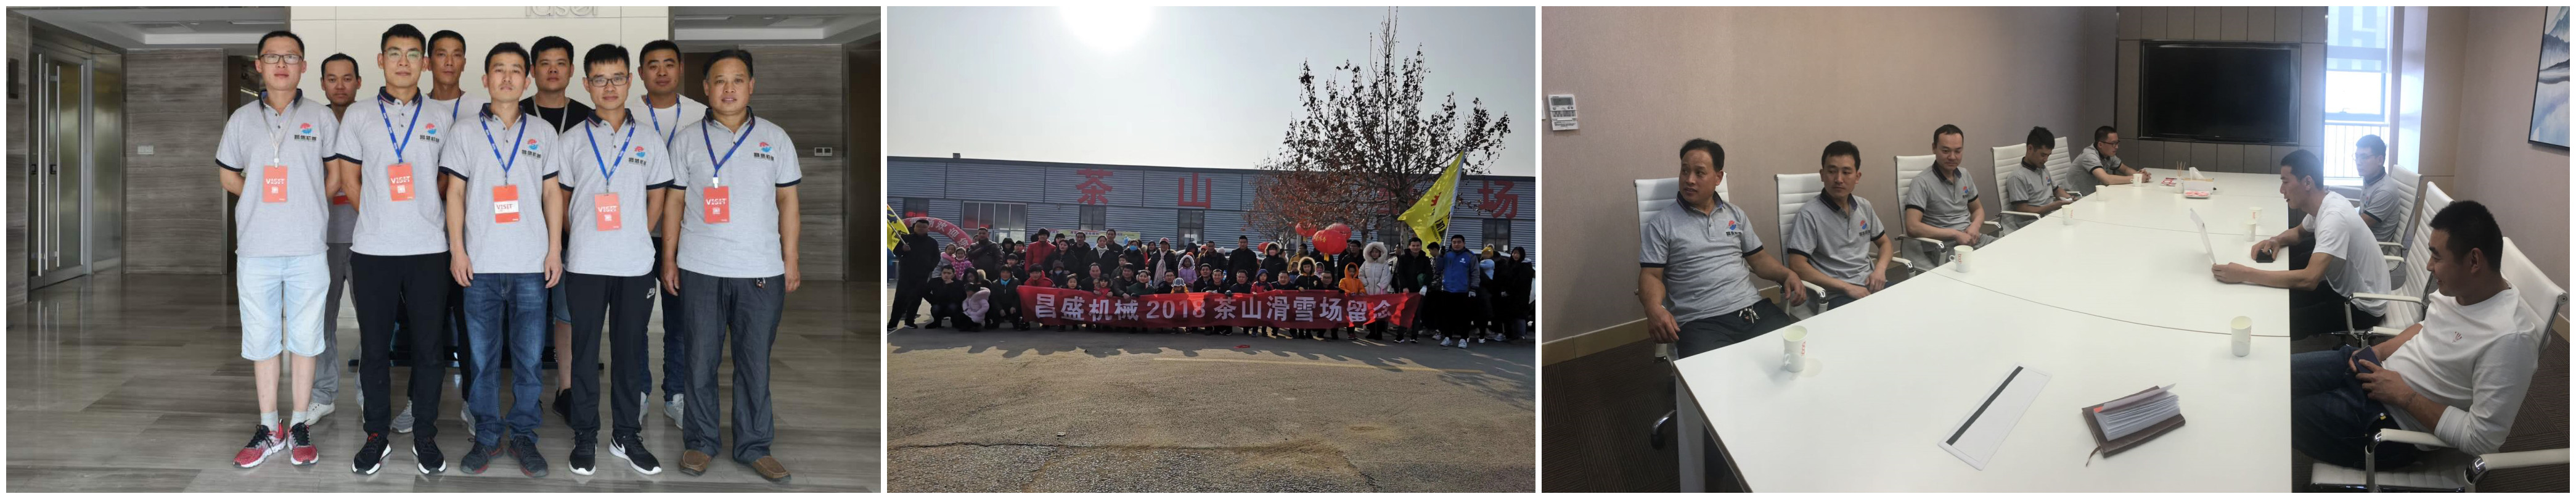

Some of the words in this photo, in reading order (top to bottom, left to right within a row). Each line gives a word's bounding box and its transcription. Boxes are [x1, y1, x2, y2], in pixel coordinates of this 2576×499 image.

[390, 175, 411, 184] VISIT
[1035, 293, 1139, 322] 昌盛机械
[1147, 299, 1206, 319] 2018
[1214, 295, 1391, 323] 茶山滑雪场留念
